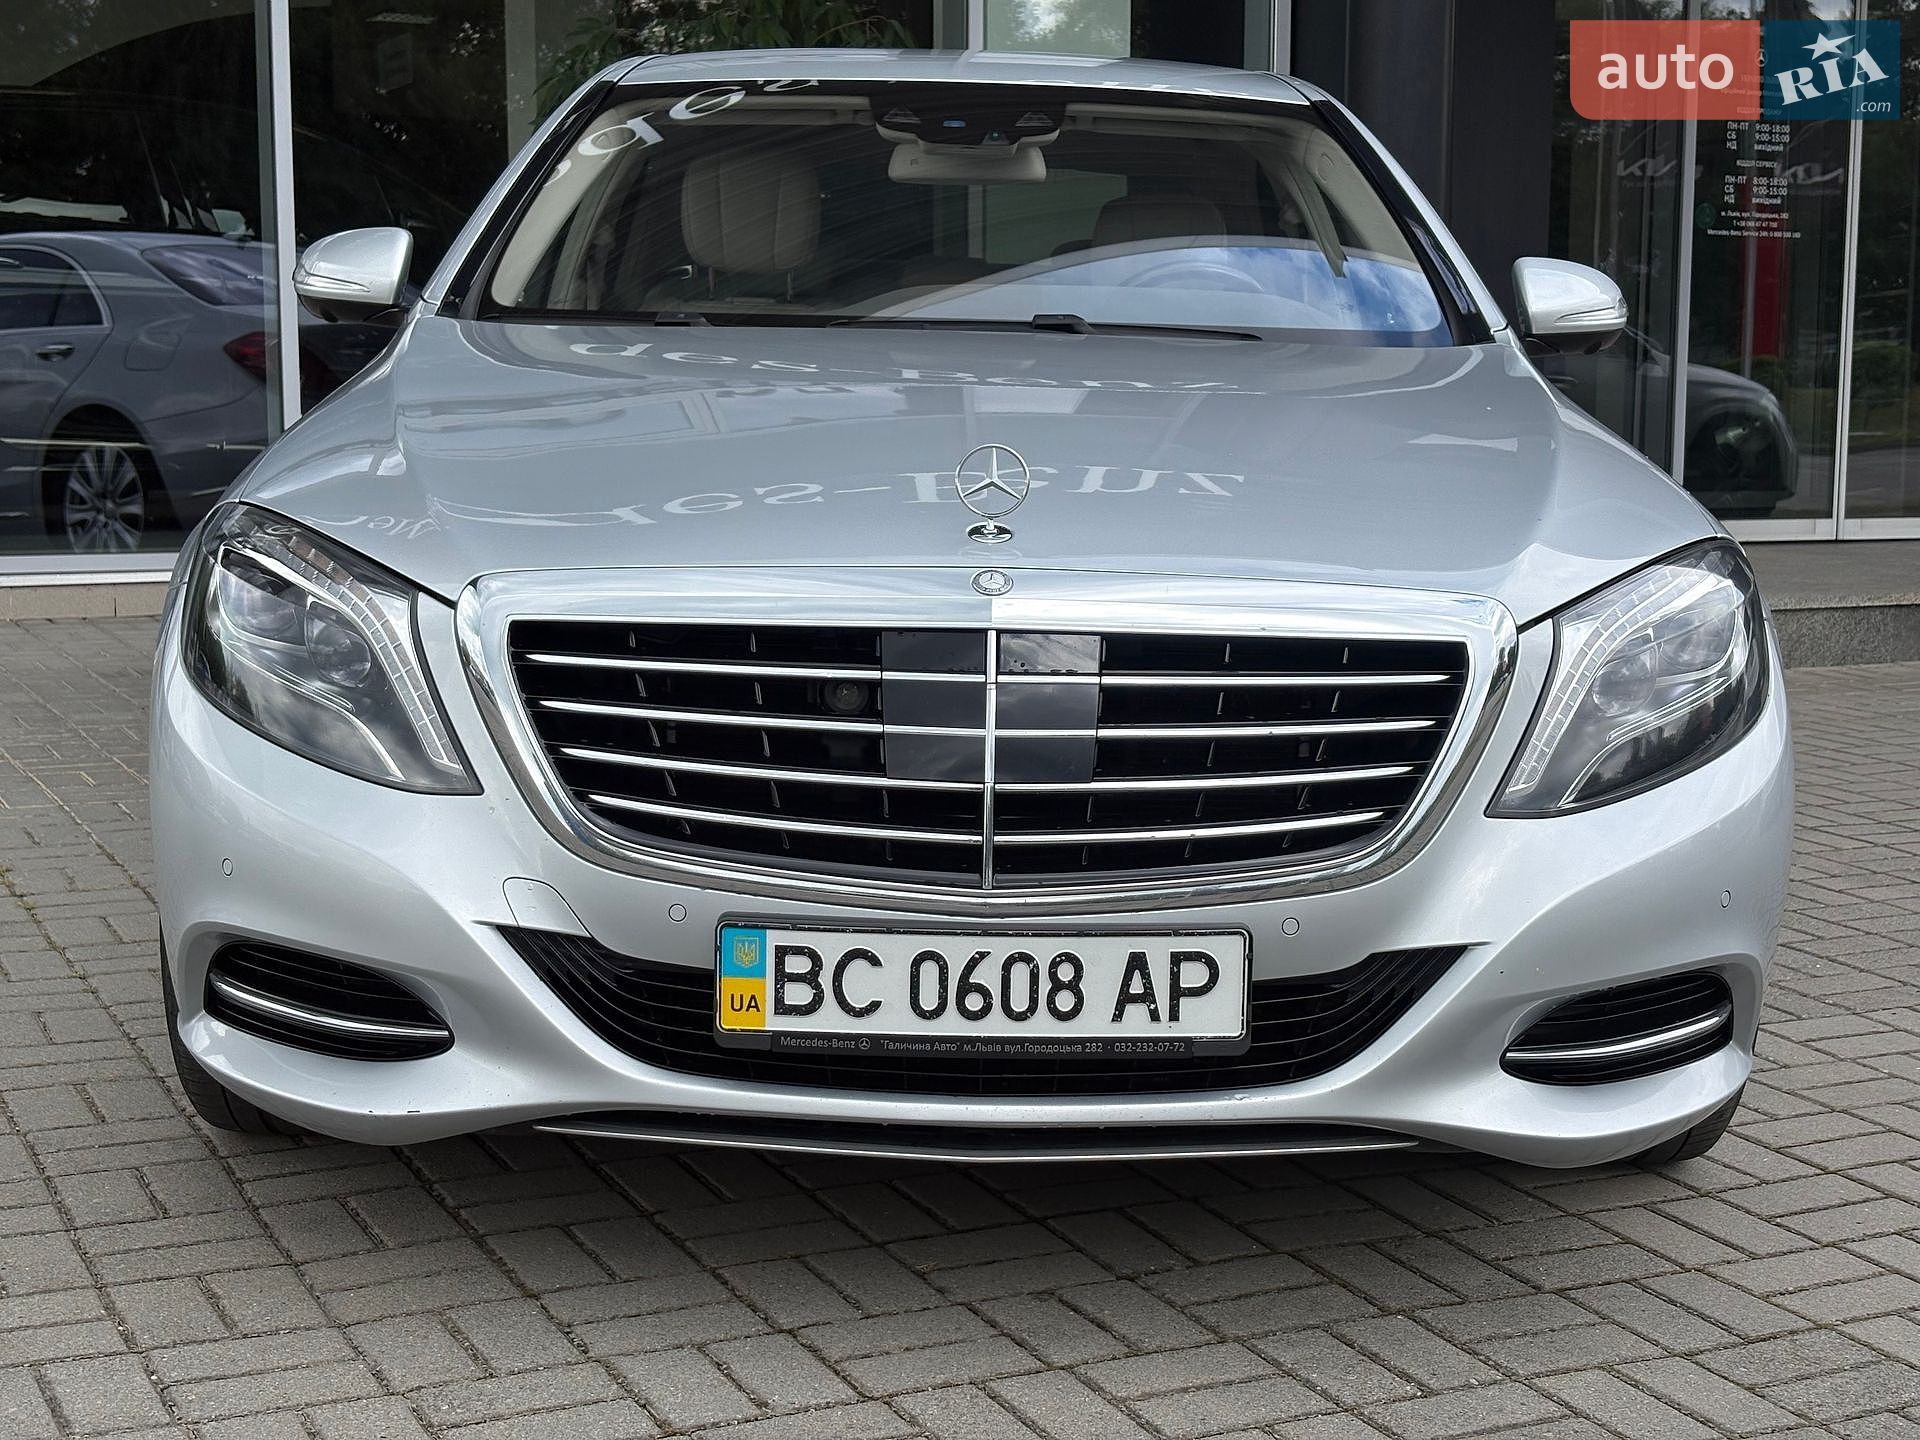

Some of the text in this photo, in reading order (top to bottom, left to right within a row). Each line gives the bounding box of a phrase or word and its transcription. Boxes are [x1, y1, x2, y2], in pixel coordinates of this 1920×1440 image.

[1727, 121, 1790, 133] ПН-ПТ 9:00-18:00
[1726, 131, 1790, 143] СБ 9:00-15:00
[1726, 140, 1737, 150] НД
[1725, 175, 1788, 186] ПН-ПТ 8:00-18:00
[1724, 184, 1735, 193] СБ
[1753, 185, 1788, 195] 9:00-15:00
[1724, 194, 1735, 204] НД
[774, 944, 1220, 1023] BC 0608 AP
[730, 994, 760, 1012] UA
[780, 1036, 856, 1049] Mercedes-Benz
[880, 1039, 931, 1052] "Галичина
[933, 1041, 960, 1053] Авто"
[1084, 1043, 1103, 1053] 282
[1114, 1043, 1185, 1053] 032-232-07-72
